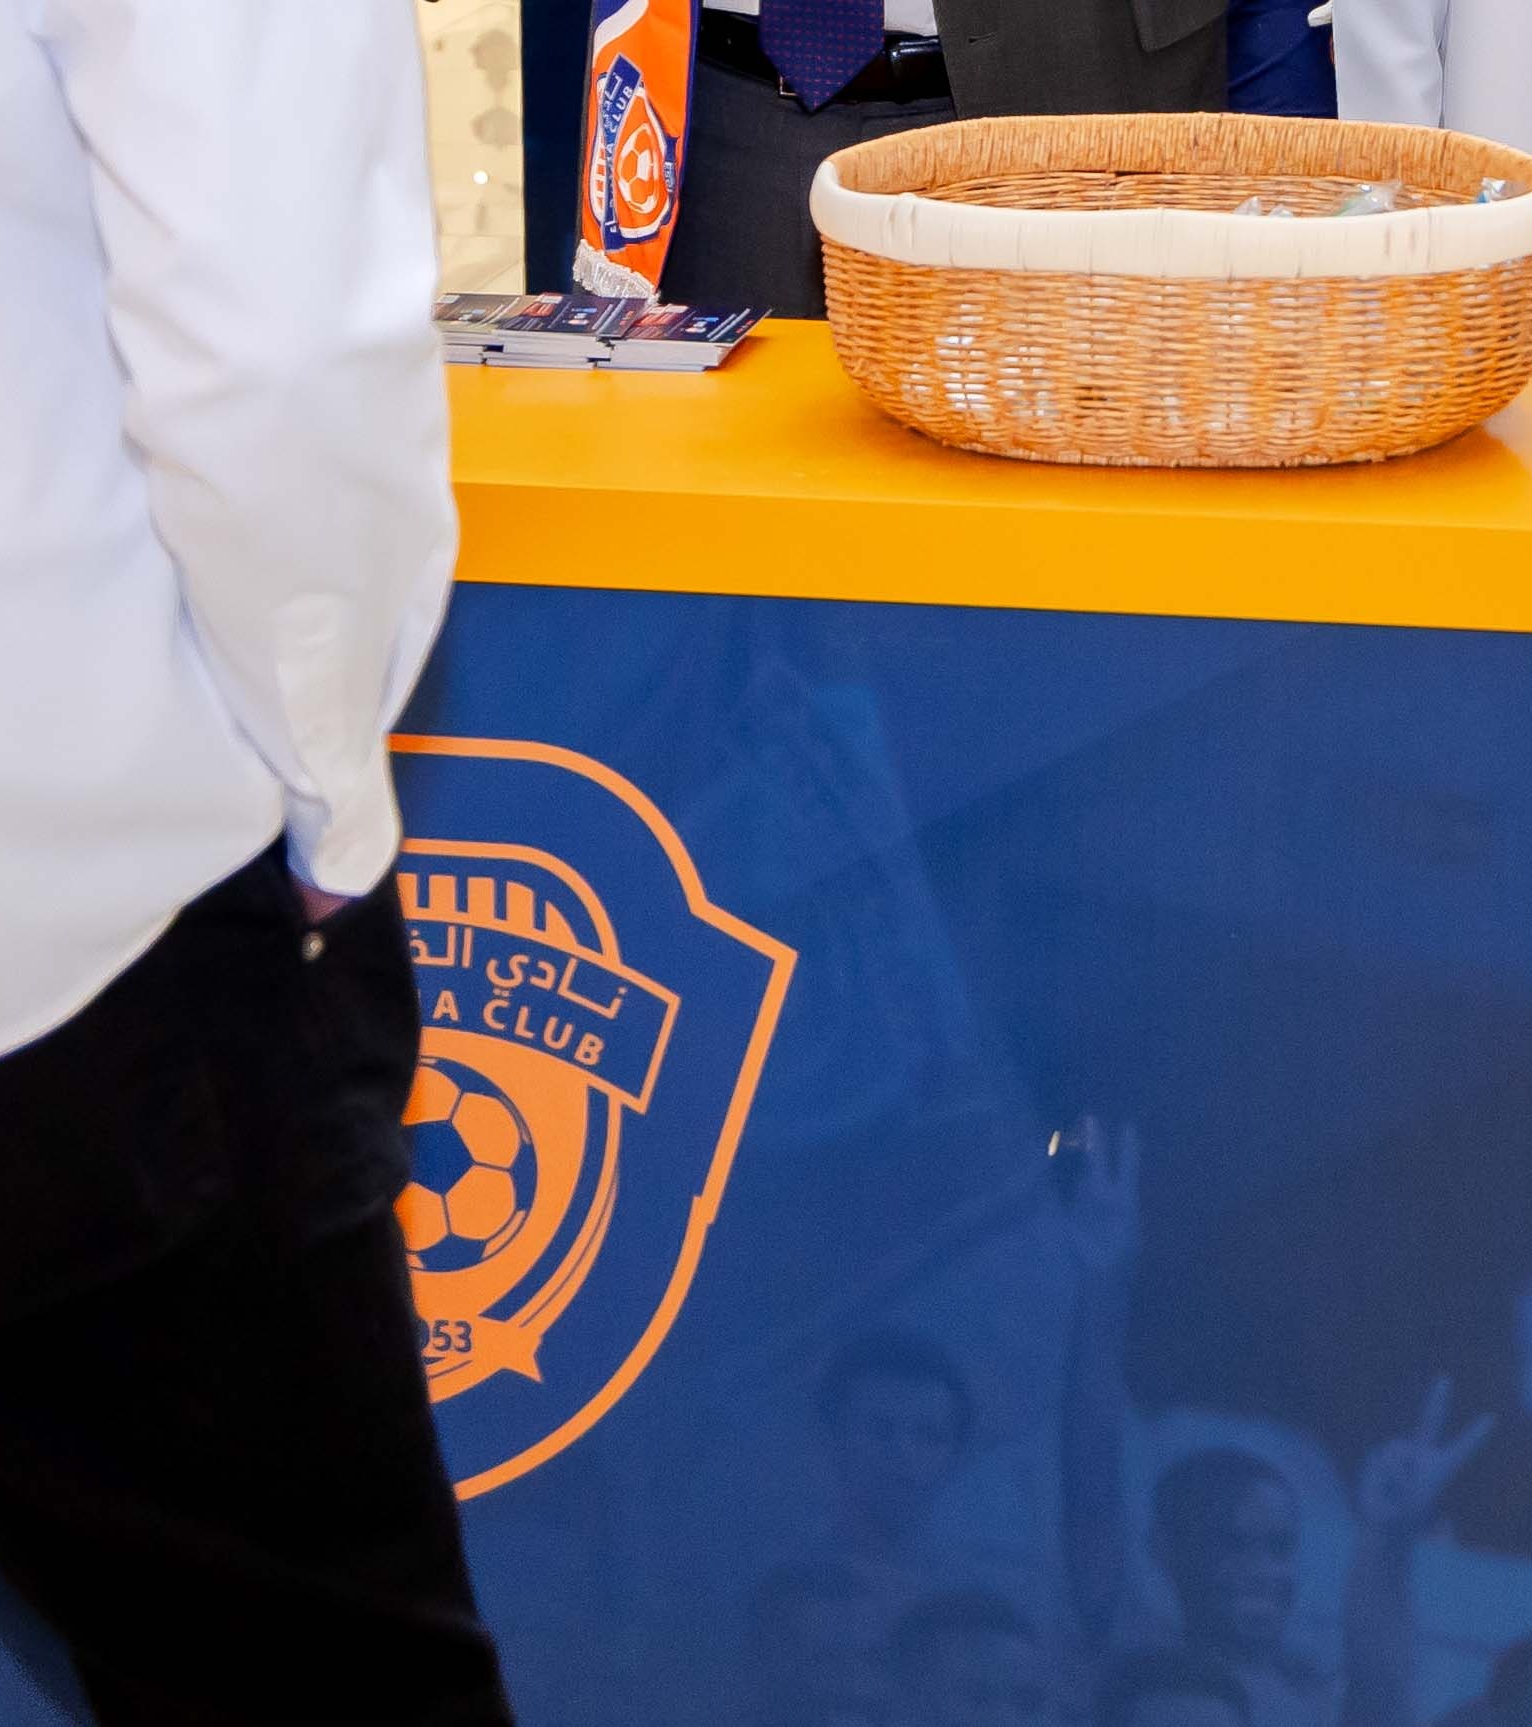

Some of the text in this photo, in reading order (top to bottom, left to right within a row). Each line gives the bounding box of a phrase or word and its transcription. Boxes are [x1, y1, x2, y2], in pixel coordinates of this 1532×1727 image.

[610, 85, 634, 134] CLUB
[486, 954, 628, 1019] نادي
[482, 998, 605, 1067] CLUB
